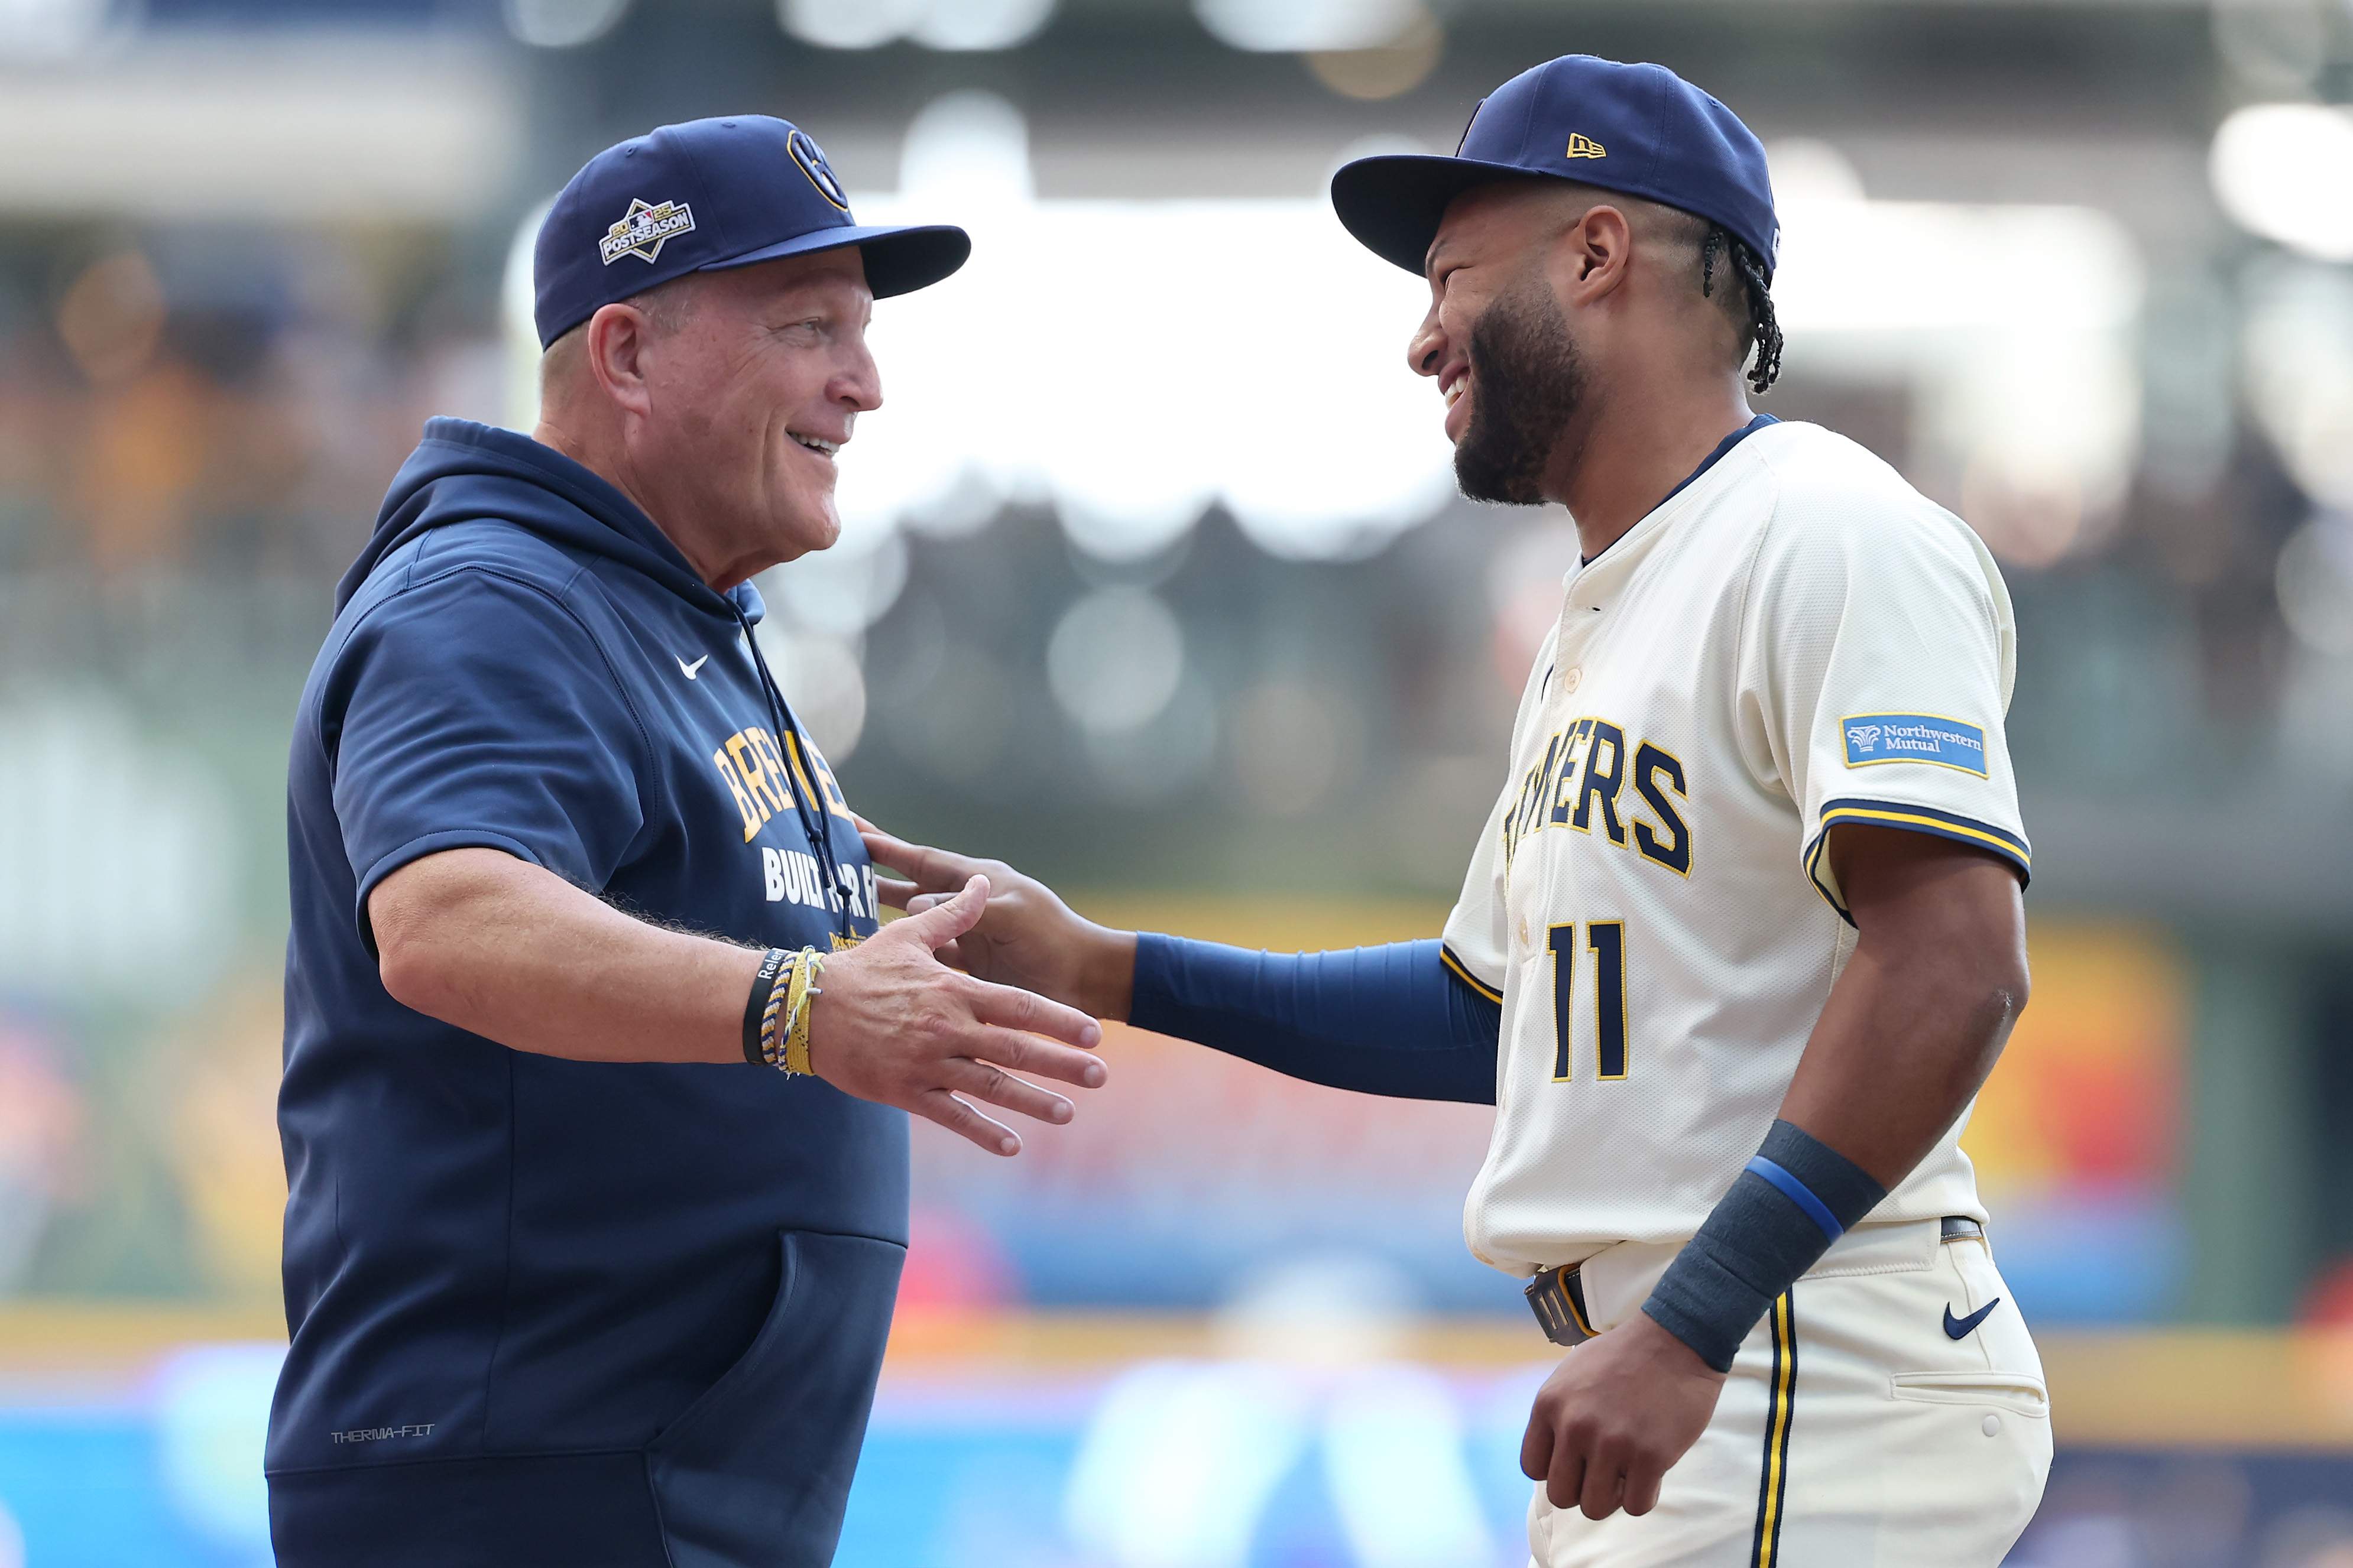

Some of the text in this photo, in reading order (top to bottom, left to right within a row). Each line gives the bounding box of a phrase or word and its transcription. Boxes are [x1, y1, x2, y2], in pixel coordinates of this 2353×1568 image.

[602, 212, 690, 257] POSTSEASON
[612, 205, 672, 236] 20 25
[1883, 725, 1982, 751] Northwestern
[1885, 738, 1941, 752] Mutual
[761, 846, 826, 910] BUILT
[1546, 919, 1629, 1083] 11
[1538, 1288, 1569, 1330] 11
[331, 1423, 436, 1444] THERMA-FIT
